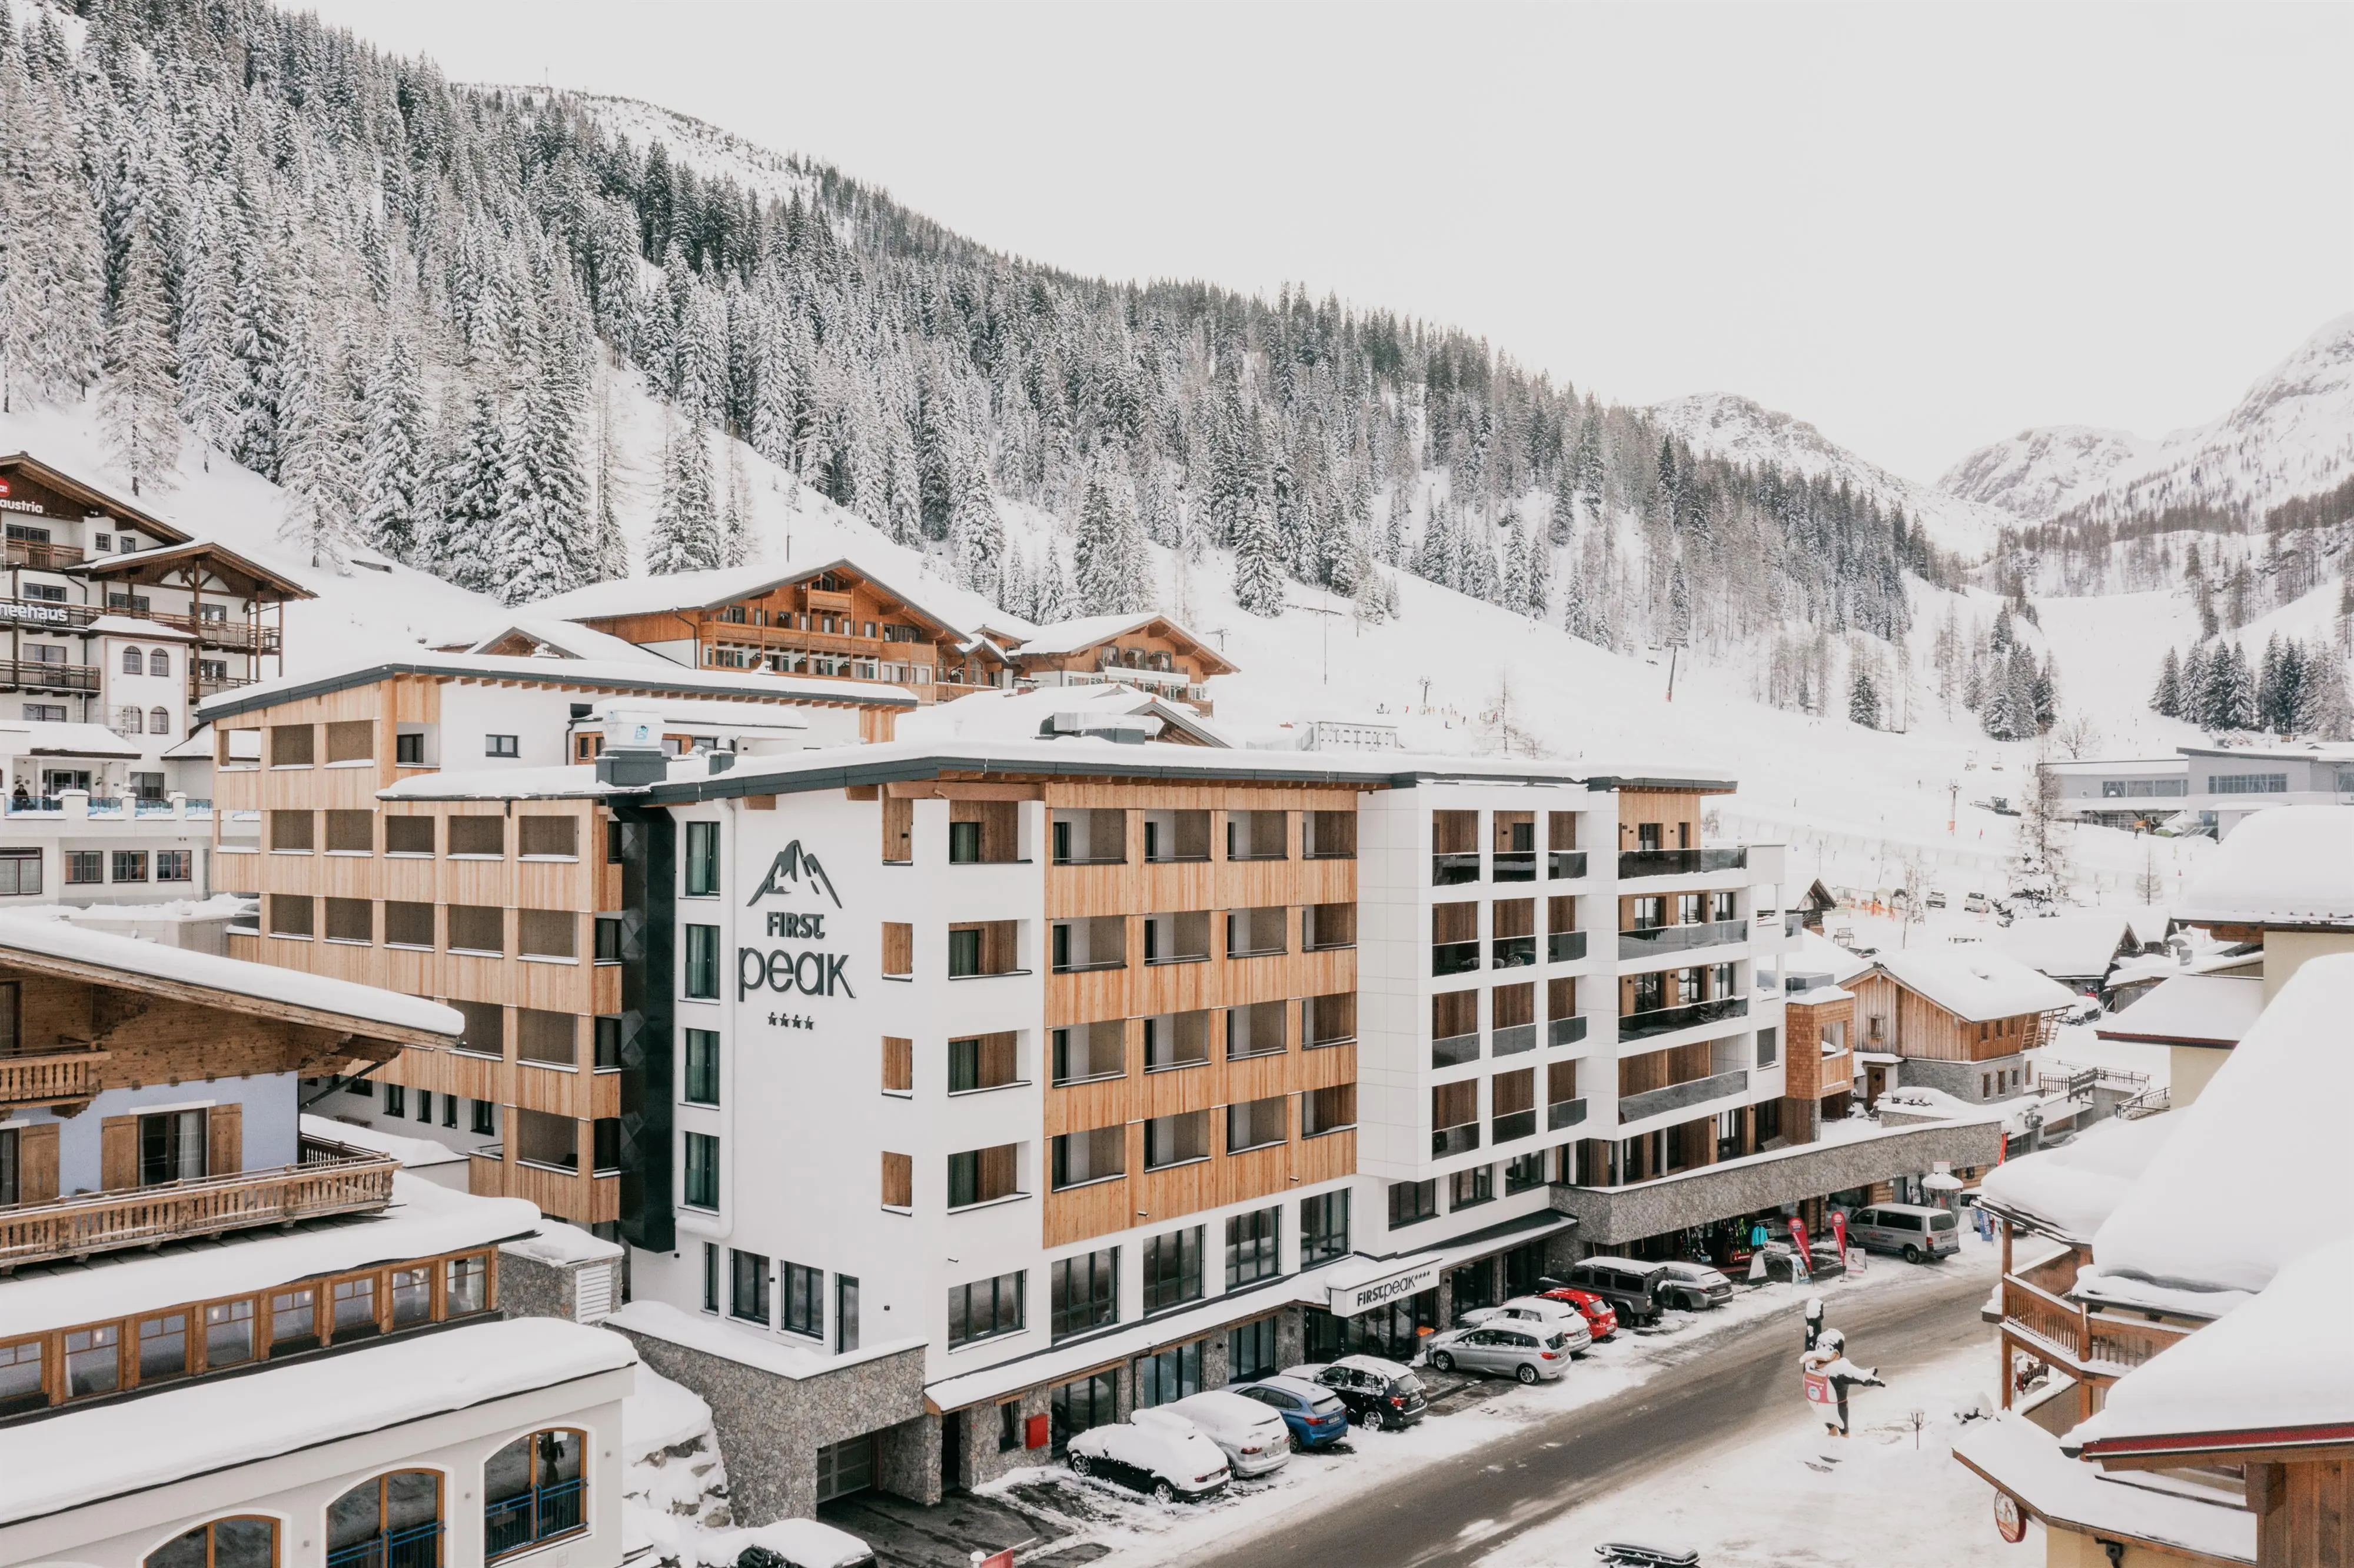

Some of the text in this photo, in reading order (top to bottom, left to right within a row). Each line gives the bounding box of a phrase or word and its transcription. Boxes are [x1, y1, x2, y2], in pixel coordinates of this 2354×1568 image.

[0, 499, 43, 514] austria
[0, 603, 68, 622] neehaus
[767, 911, 825, 940] FIRST
[739, 947, 856, 1002] peak
